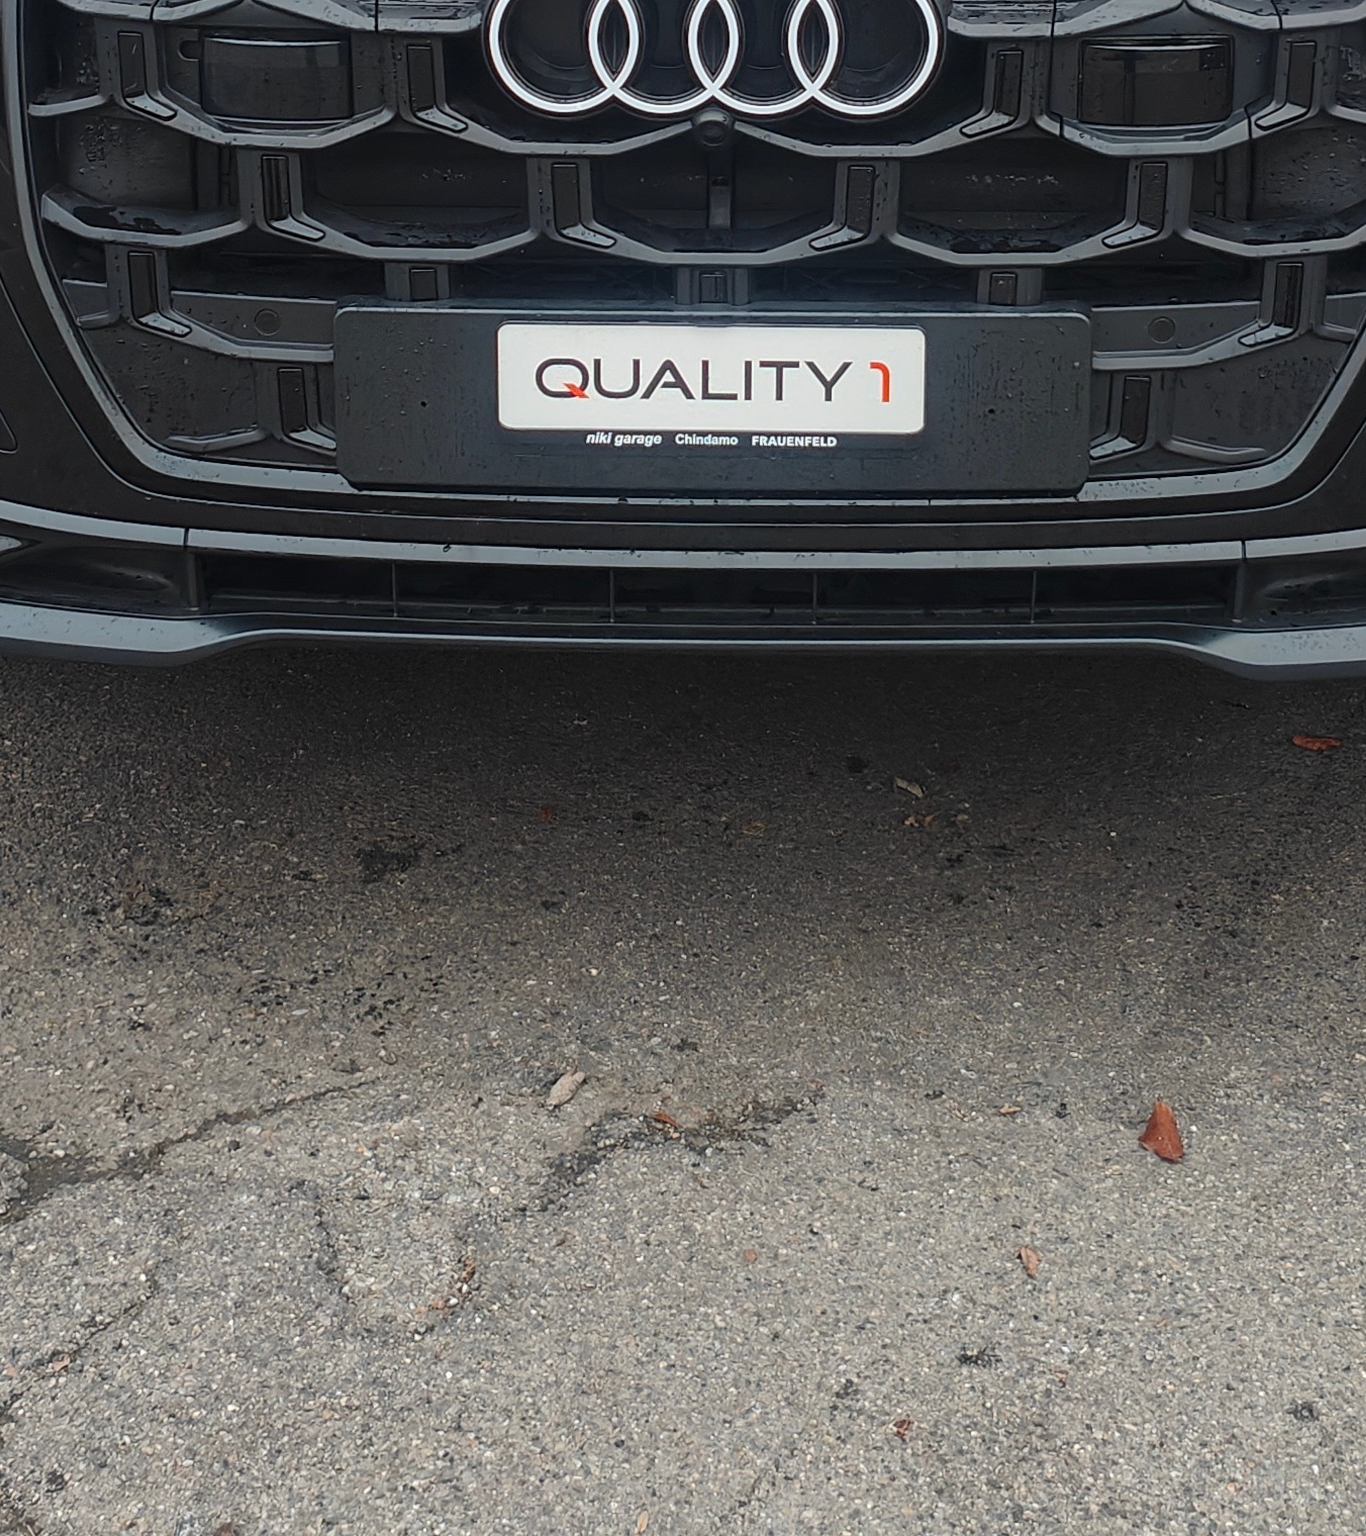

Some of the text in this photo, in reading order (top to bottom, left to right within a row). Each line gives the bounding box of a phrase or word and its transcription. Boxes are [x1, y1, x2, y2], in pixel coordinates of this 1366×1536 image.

[534, 357, 853, 402] QUALITY
[585, 431, 838, 448] niki garage Chindamo FRAUENFELD
